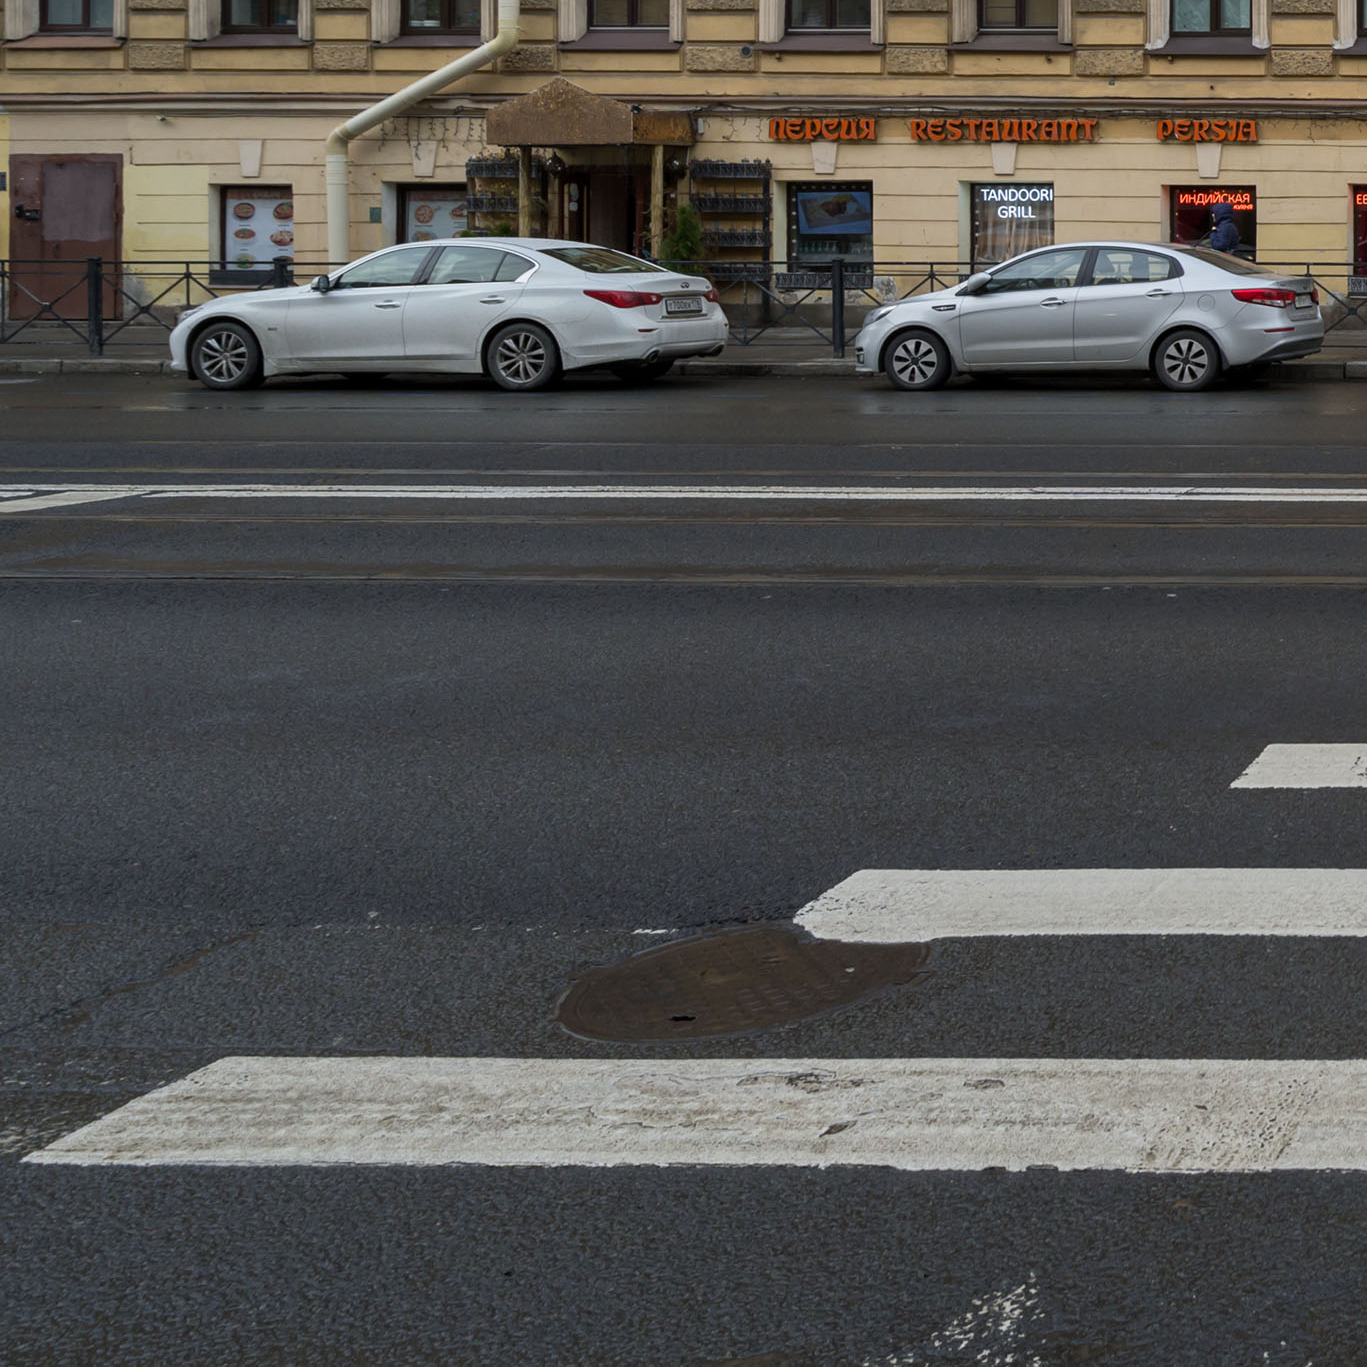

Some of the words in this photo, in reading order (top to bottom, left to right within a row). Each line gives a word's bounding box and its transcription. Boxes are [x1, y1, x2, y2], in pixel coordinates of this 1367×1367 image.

[768, 118, 877, 141] ПЕРСИЯ
[910, 118, 1097, 141] RESTAURANT
[1156, 119, 1258, 142] PERSIA
[981, 188, 1053, 202] TANDOORI
[1179, 191, 1250, 206] ИНДИЙСКАЯ
[997, 205, 1036, 218] GRILL
